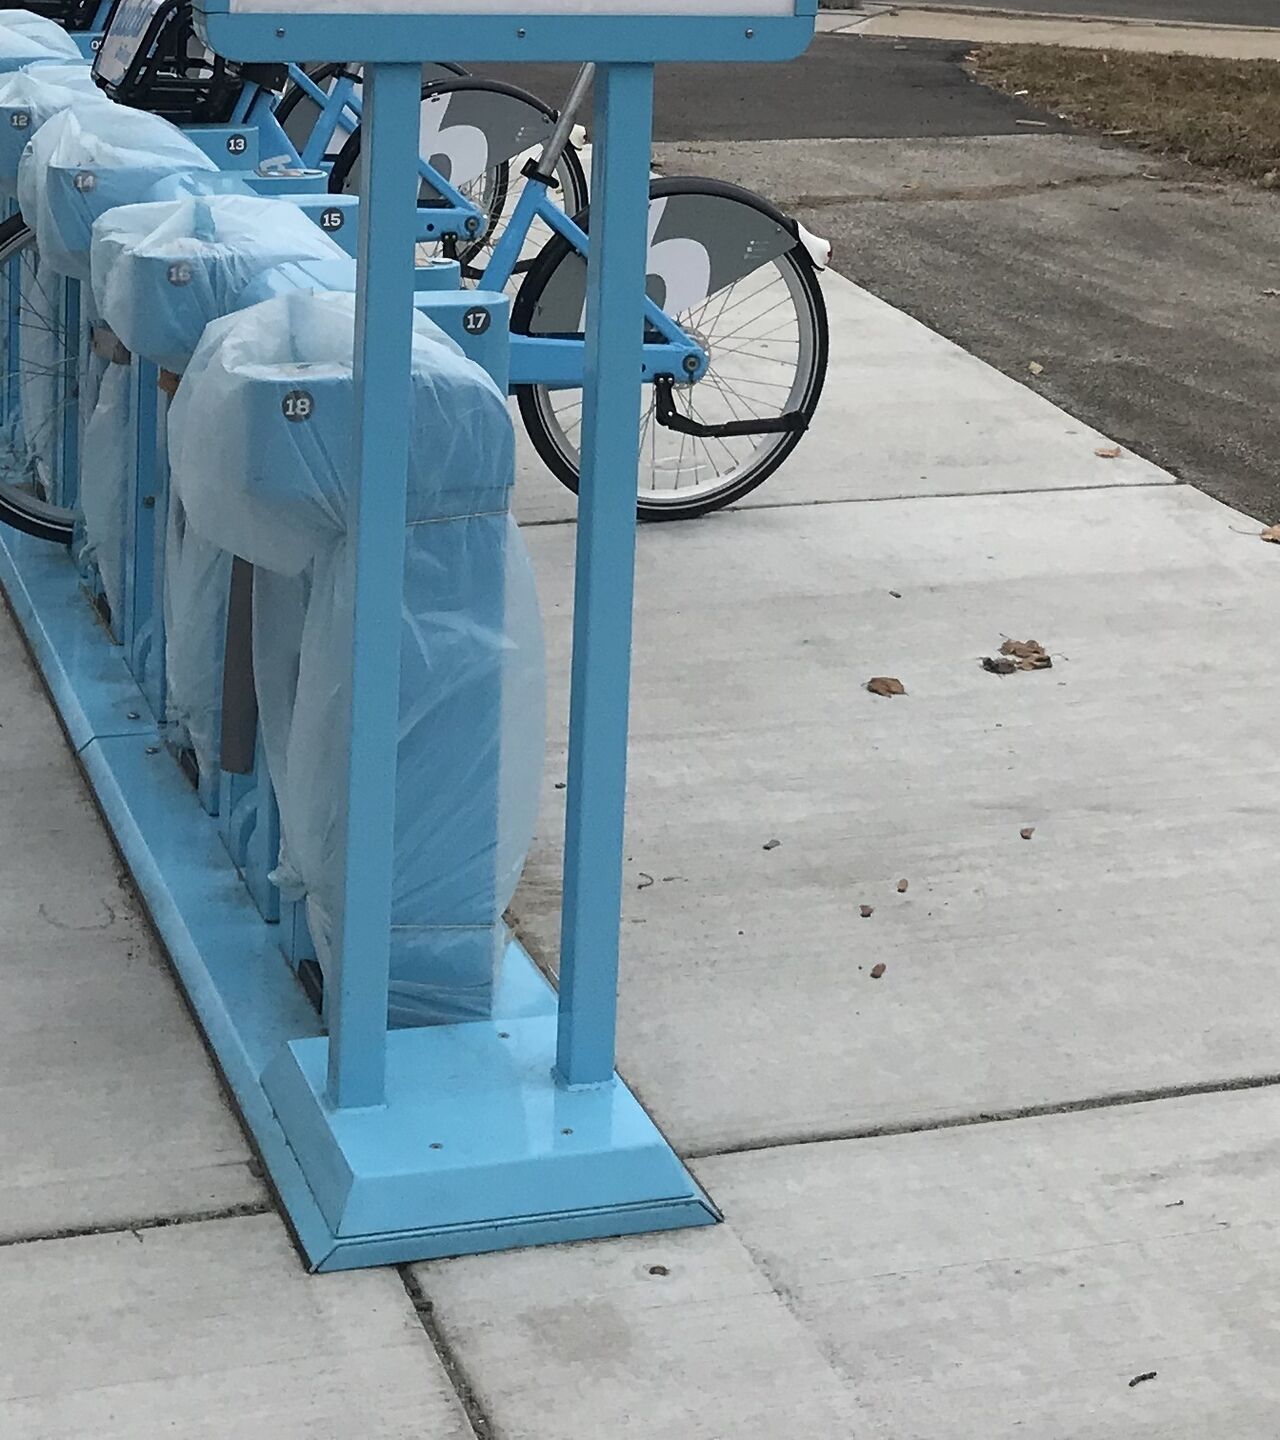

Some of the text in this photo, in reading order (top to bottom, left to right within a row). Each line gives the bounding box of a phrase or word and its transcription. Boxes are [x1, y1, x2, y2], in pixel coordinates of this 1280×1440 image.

[11, 114, 28, 126] 12
[228, 138, 245, 151] 13
[76, 174, 94, 189] 14
[322, 212, 341, 228] 15
[169, 265, 190, 282] 16
[466, 313, 488, 329] 17
[285, 398, 311, 417] 18
